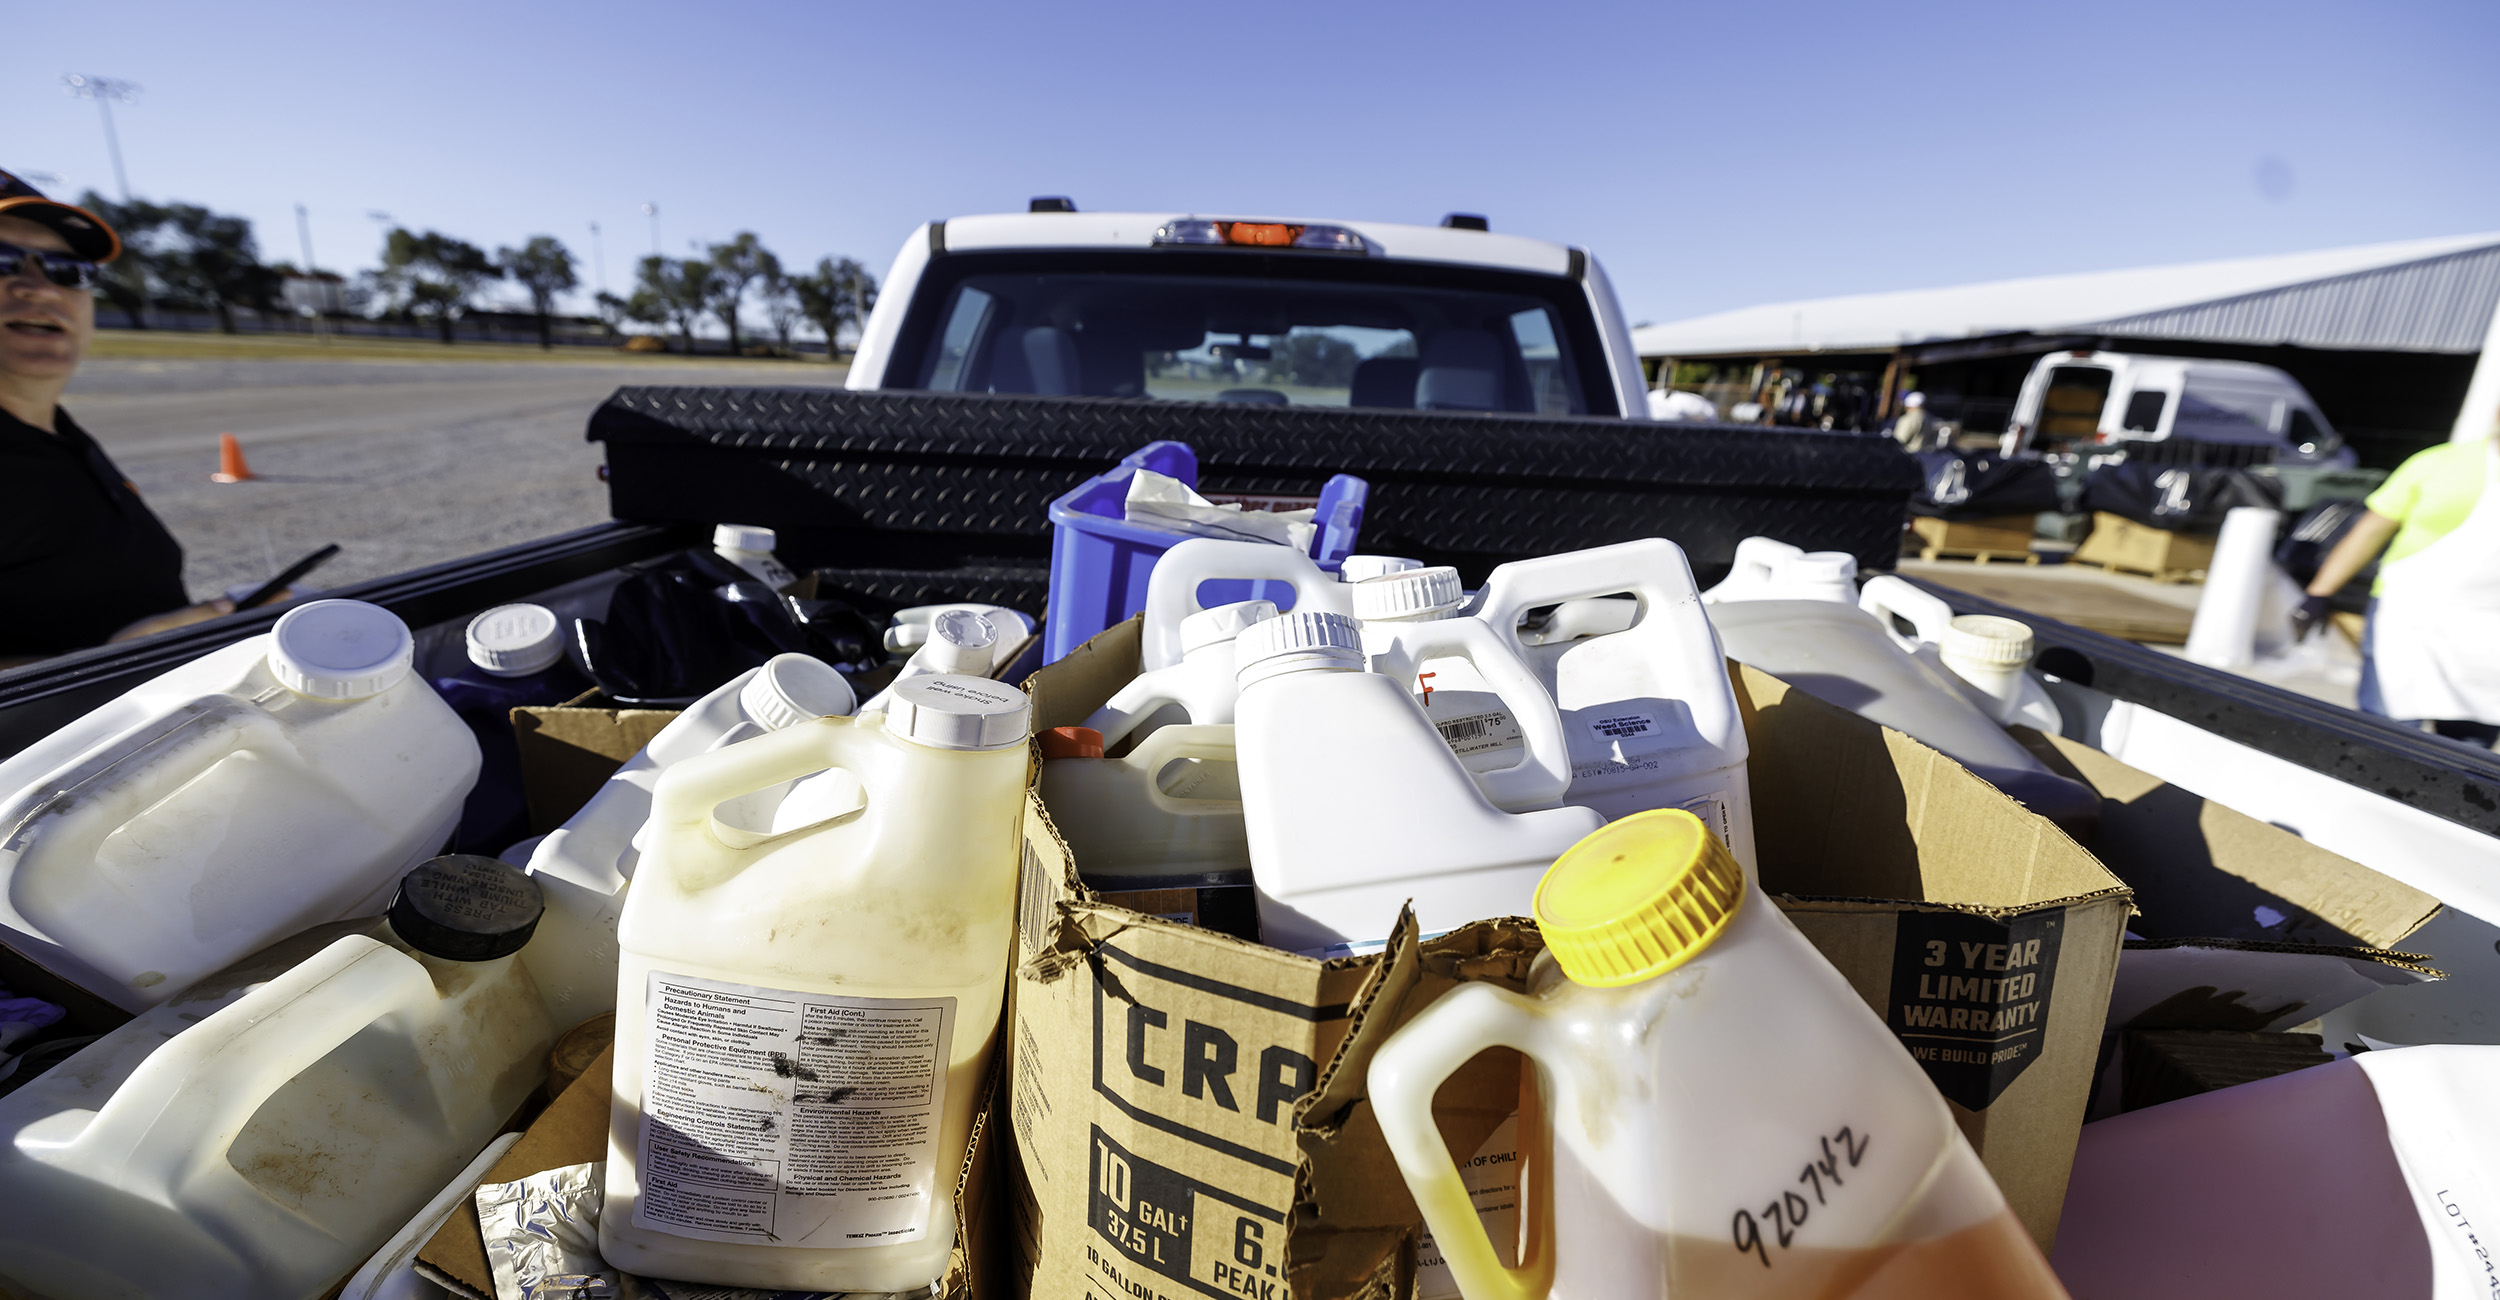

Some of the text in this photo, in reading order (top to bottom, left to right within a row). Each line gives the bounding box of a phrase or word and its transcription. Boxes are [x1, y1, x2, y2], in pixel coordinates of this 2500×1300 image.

[926, 686, 992, 706] Shake well
[967, 689, 1009, 703] before
[1418, 672, 1436, 708] F
[1452, 714, 1484, 724] RESTRICTED
[1592, 718, 1651, 730] Weed Science
[1612, 714, 1640, 723] Extension
[1454, 743, 1489, 754] STILLWATER
[420, 879, 527, 909] THUMB WHILE
[432, 871, 524, 898] UNSCREWING
[433, 892, 507, 914] TAB WITH
[444, 904, 493, 920] PRESS
[1924, 938, 2041, 972] 3 YEAR
[665, 985, 750, 1005] Precautionary Statement
[1919, 972, 2036, 1004] LIMITED
[663, 1003, 724, 1019] Domestic Animals
[664, 995, 691, 1006] Hazards
[702, 1002, 730, 1013] Humans
[732, 1007, 746, 1015] and
[841, 1009, 865, 1018] (Cont.)
[656, 1007, 673, 1015] Causes
[674, 1010, 696, 1019] Moderate
[707, 1016, 728, 1024] Irritation
[732, 1020, 752, 1028] Harmful
[757, 1024, 784, 1032] Swallowed
[656, 1012, 680, 1023] Prolonged
[687, 1018, 712, 1029] Frequently
[713, 1023, 736, 1032] Repeated
[1903, 1000, 2040, 1032] WARRANTY
[669, 1026, 686, 1034] contact
[671, 1020, 689, 1029] Allergic
[689, 1023, 710, 1031] Reaction
[717, 1027, 731, 1035] Some
[732, 1030, 757, 1039] Individuals
[661, 1032, 786, 1059] Personal Protective Equipment (PPE)
[1913, 1046, 1938, 1061] WE
[1942, 1048, 1987, 1064] BUILD
[654, 1058, 678, 1069] Applicators
[689, 1065, 701, 1073] other
[702, 1068, 722, 1077] handlers
[657, 1108, 694, 1123] Engineering
[696, 1116, 725, 1127] Controls
[800, 1107, 850, 1115] Environmental
[654, 1143, 755, 1166] User Safety Recommendations
[1474, 1156, 1487, 1167] OF
[651, 1176, 677, 1187] First Aid
[793, 1174, 822, 1182] Physical
[872, 1172, 901, 1180] Hazards
[1096, 1138, 1132, 1214] 10
[1732, 1126, 1870, 1270] 920742
[1108, 1209, 1166, 1265] 37.5 L
[1234, 1216, 1288, 1284] 6.
[1086, 1244, 1153, 1300] 10 GALLON
[1214, 1260, 1276, 1300] PEAK
